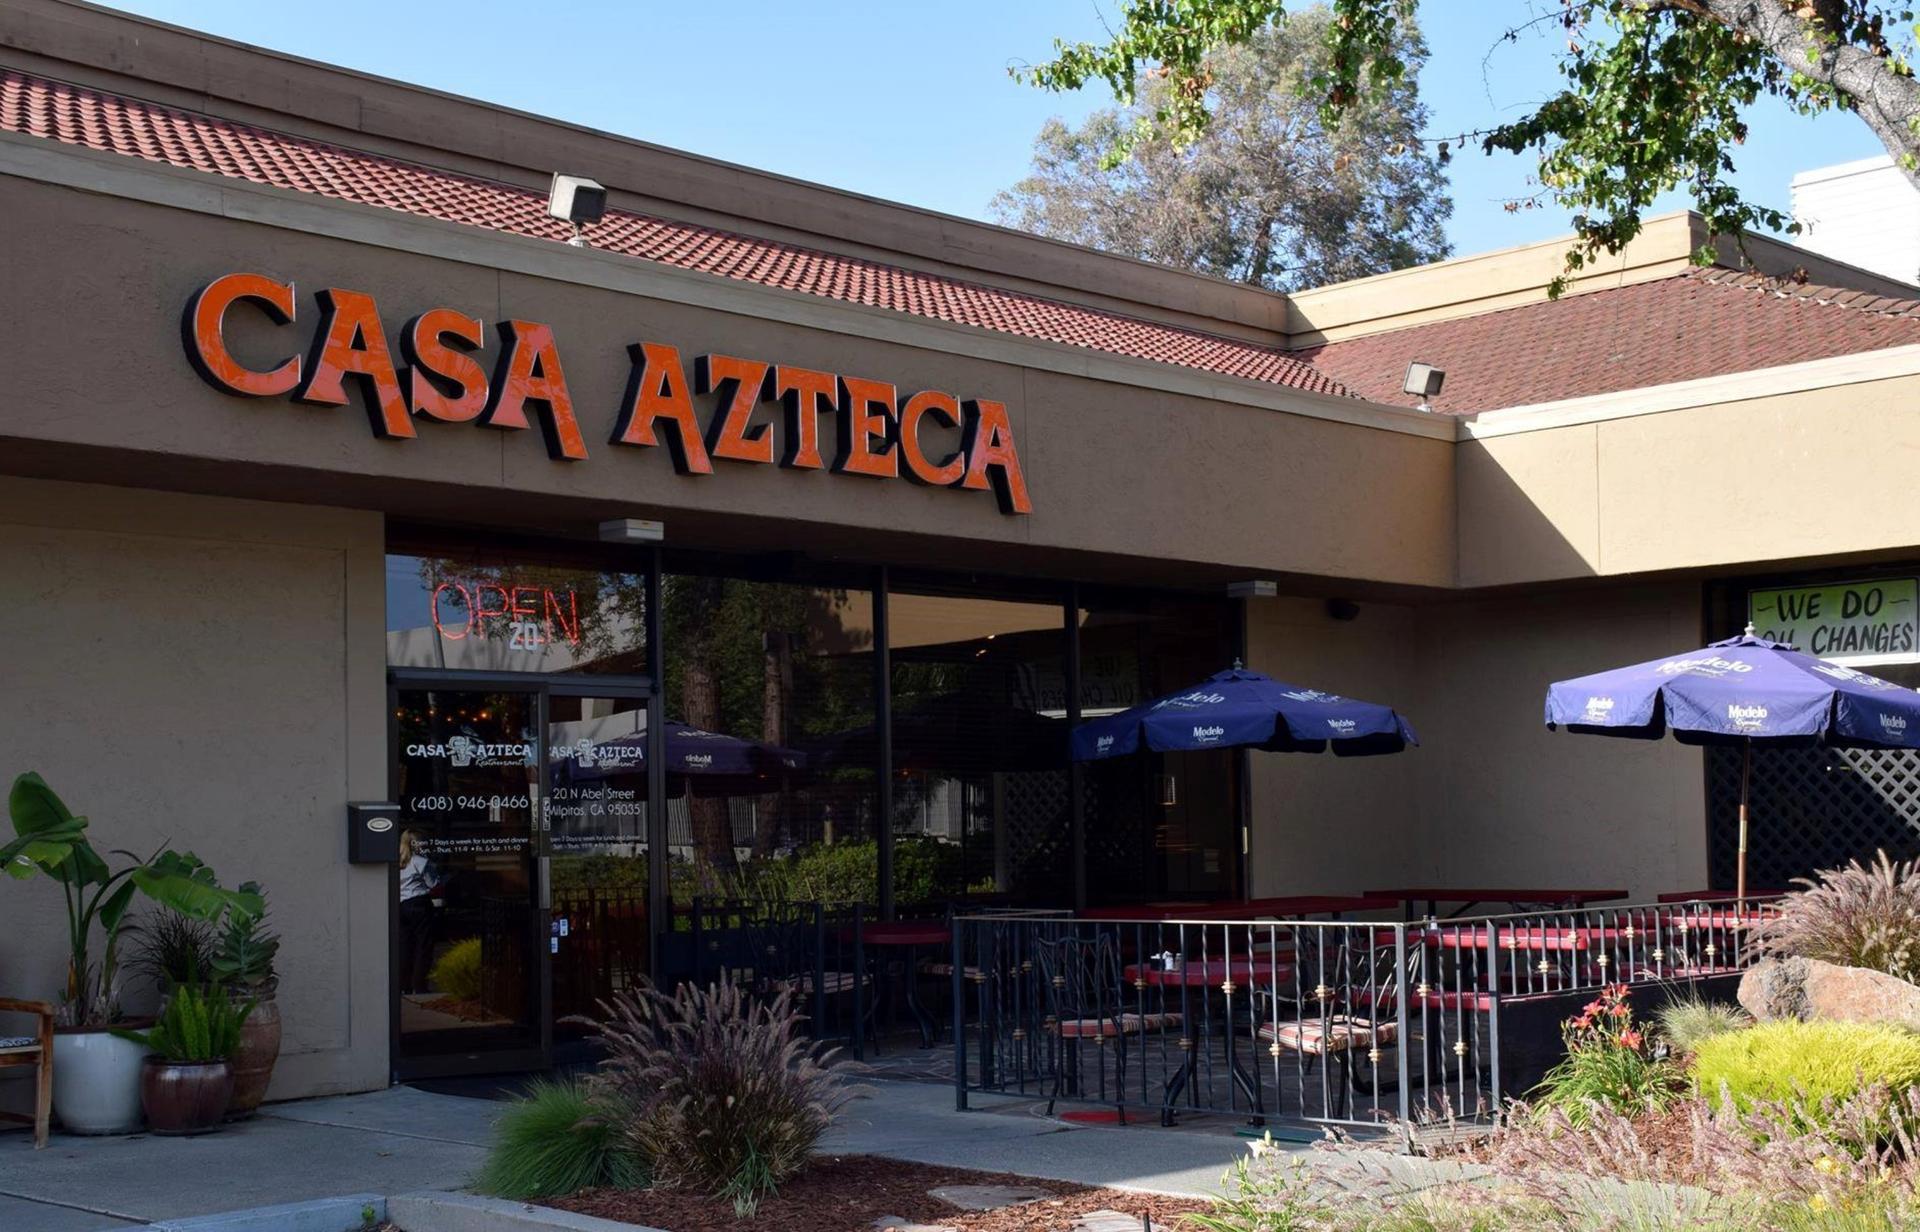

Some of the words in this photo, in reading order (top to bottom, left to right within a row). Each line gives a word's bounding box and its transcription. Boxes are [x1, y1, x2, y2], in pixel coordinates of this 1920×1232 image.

[183, 273, 589, 461] CASA
[609, 341, 1032, 514] AZTECA
[1777, 593, 1822, 622] WE
[1841, 588, 1883, 619] DO
[433, 583, 580, 646] OPEN
[509, 622, 539, 650] 20
[1811, 622, 1914, 654] CHANGES
[1728, 704, 1768, 719] Modelo
[1880, 712, 1906, 729] Modelo
[1193, 725, 1225, 737] Modelo
[406, 744, 446, 758] CASA
[476, 744, 533, 758] AZTECA
[549, 746, 576, 759] ASA
[599, 747, 644, 759] AZTECA
[553, 788, 567, 799] 20
[570, 788, 578, 799] N
[581, 787, 603, 799] Abel
[607, 788, 635, 799] Street
[411, 796, 453, 812] (408)
[457, 795, 529, 809] 946-0466
[549, 804, 587, 819] Milpitas,
[590, 804, 606, 815] CA
[607, 804, 641, 815] 95035
